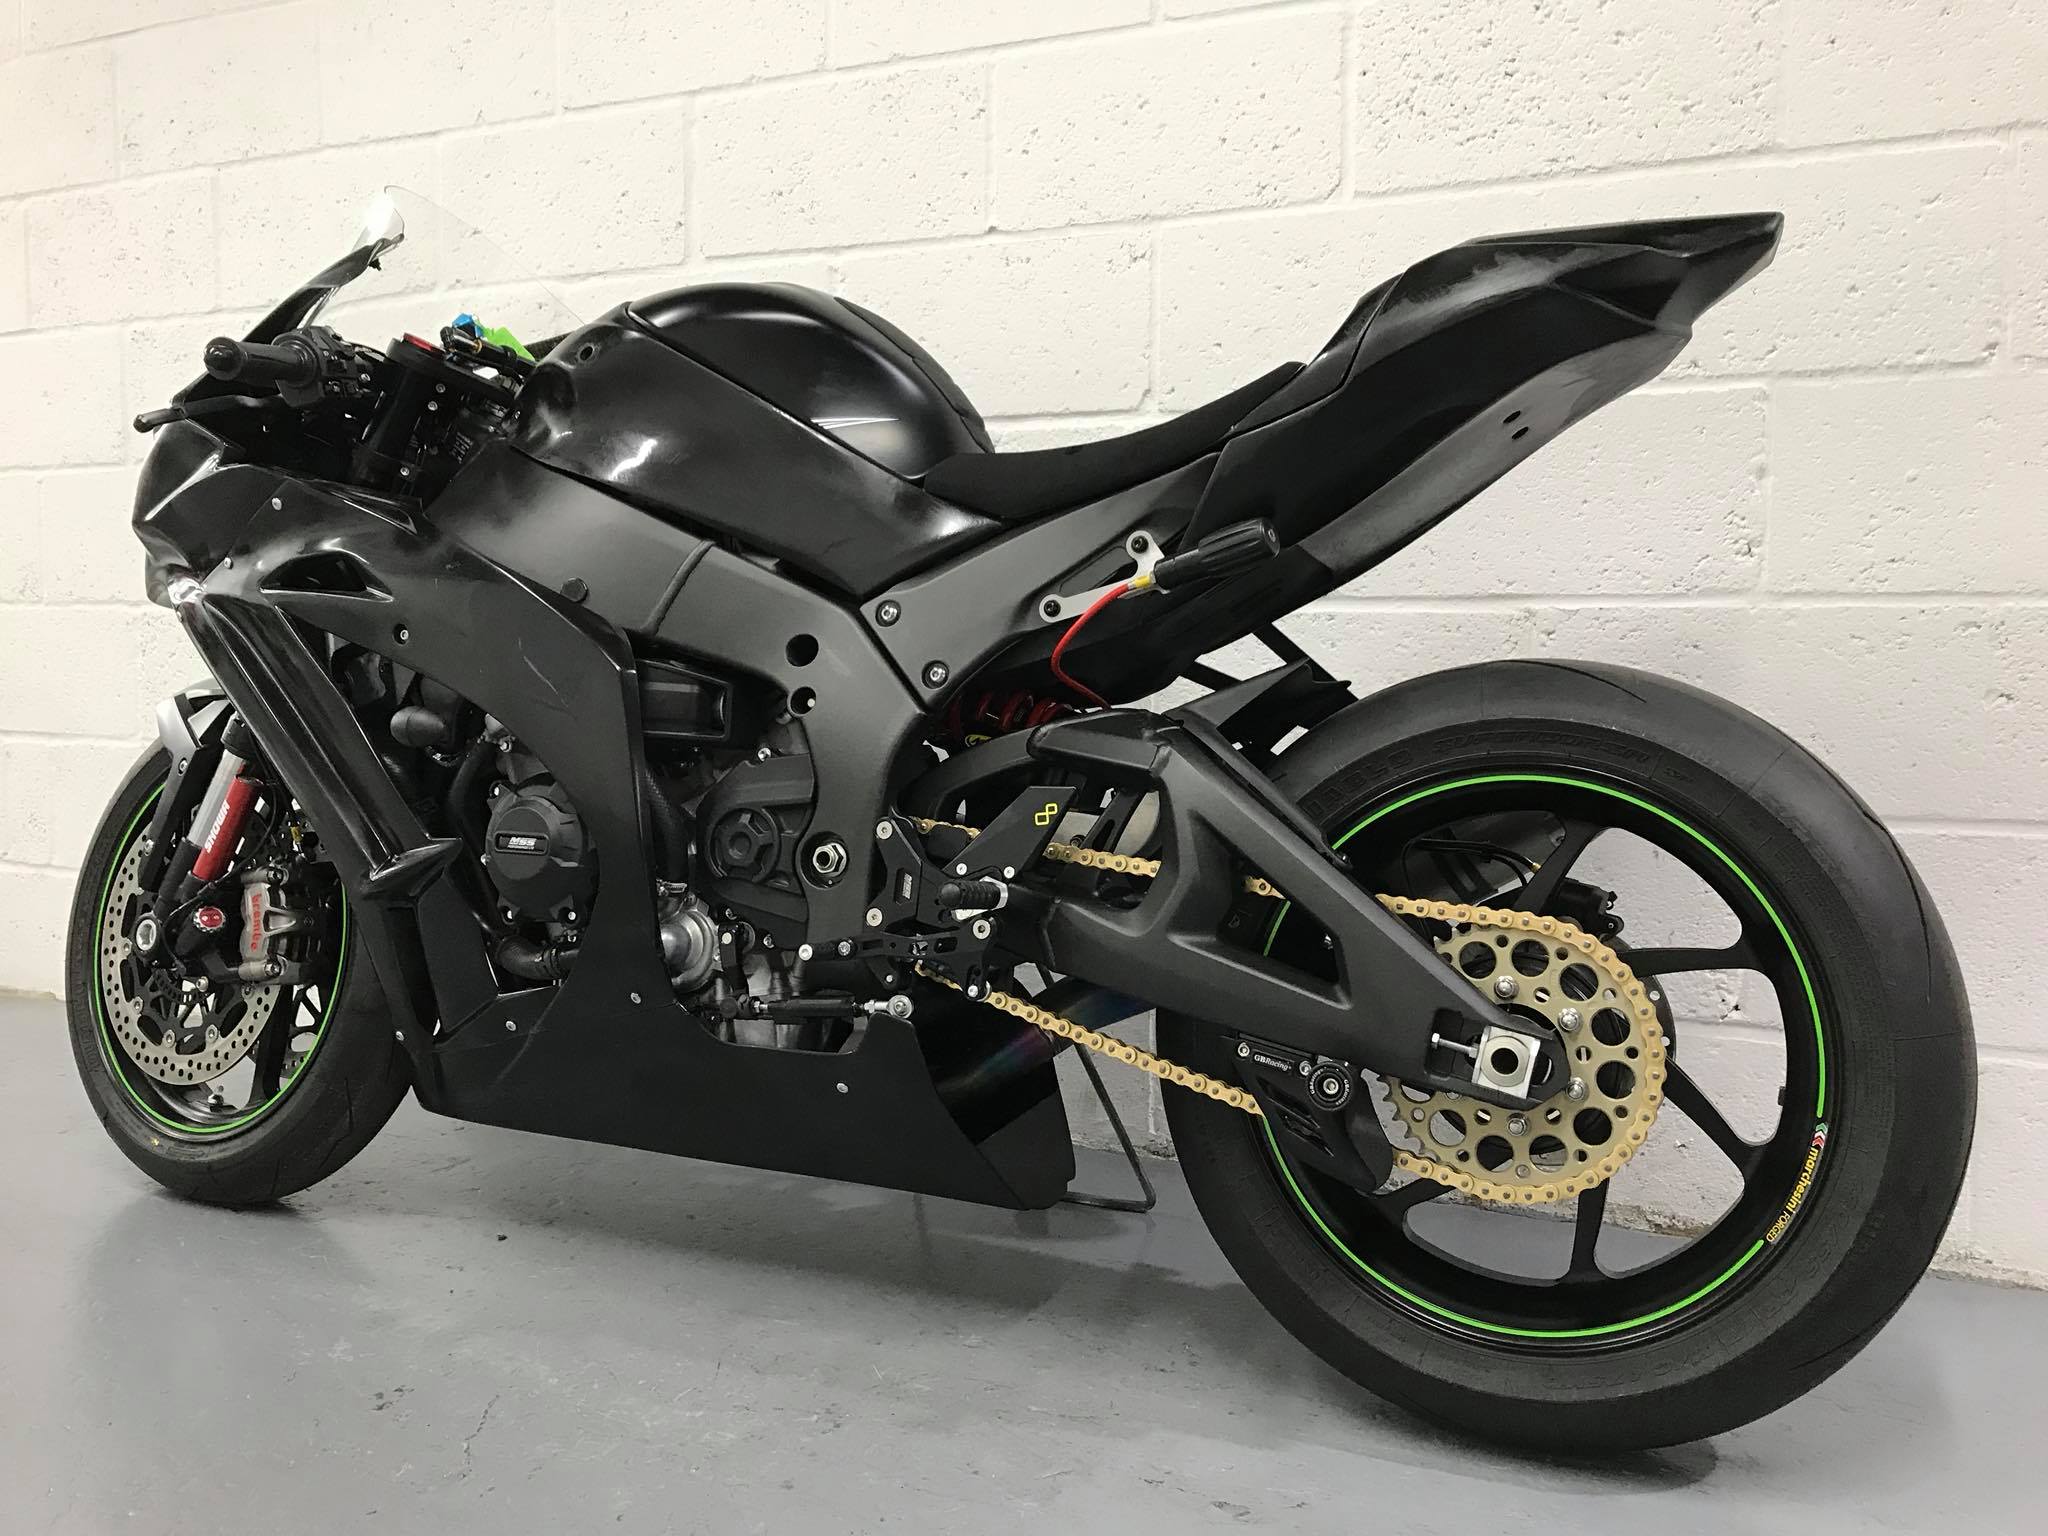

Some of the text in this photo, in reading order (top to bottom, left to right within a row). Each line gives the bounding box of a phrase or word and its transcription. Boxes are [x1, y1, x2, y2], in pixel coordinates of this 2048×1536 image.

[204, 799, 231, 854] SHOWA
[1765, 1147, 1819, 1242] marchesini FORGED
